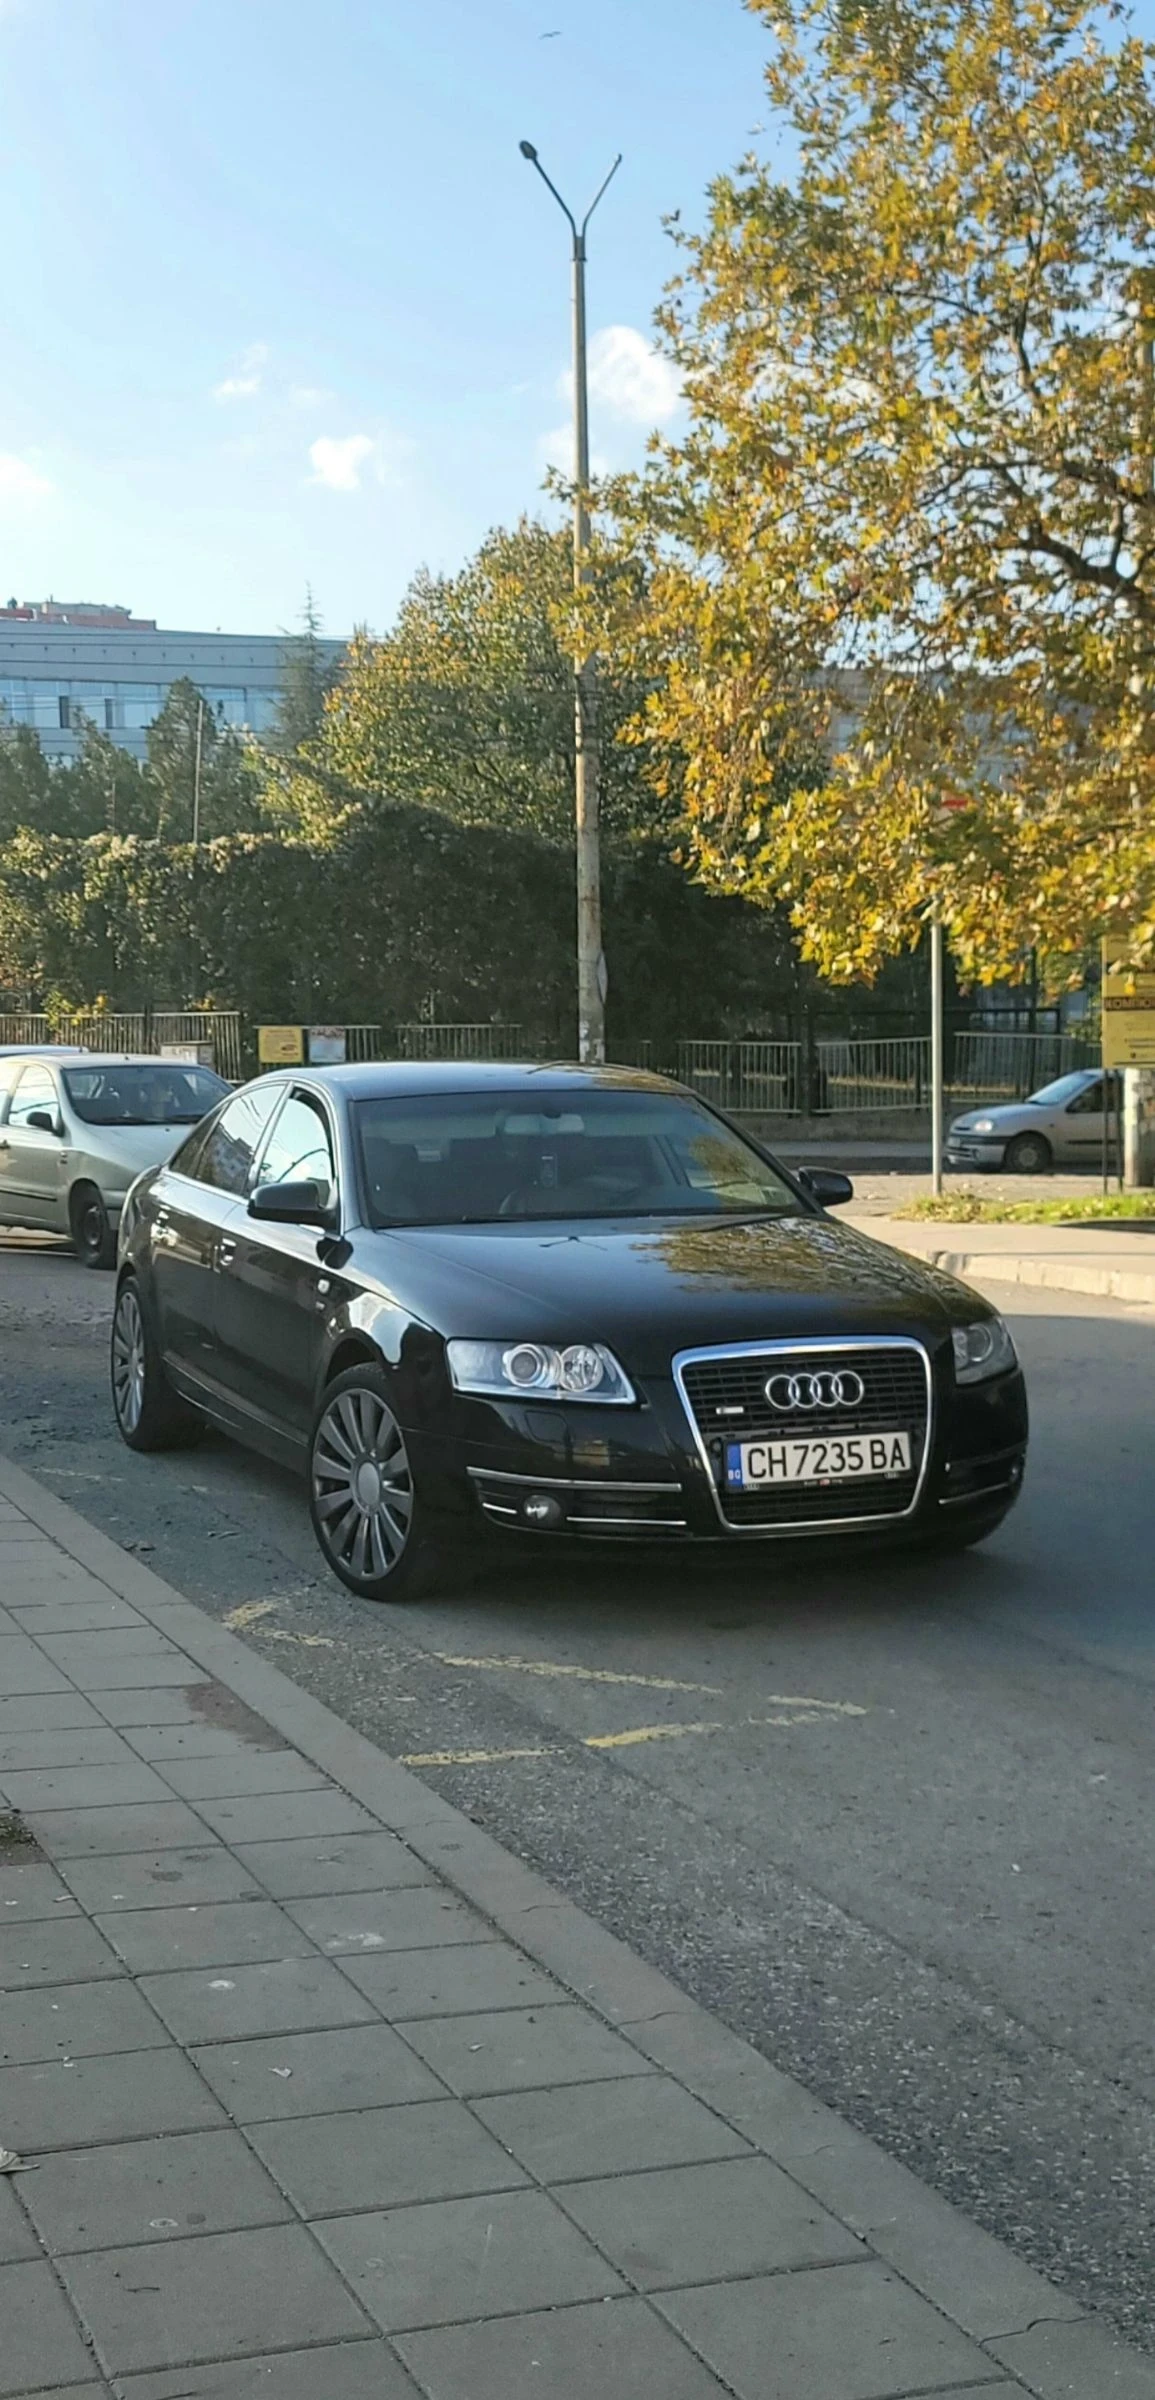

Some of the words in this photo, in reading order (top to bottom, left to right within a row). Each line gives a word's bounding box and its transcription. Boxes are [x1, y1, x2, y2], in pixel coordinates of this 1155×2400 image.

[748, 1446, 787, 1479] CH
[793, 1441, 864, 1476] 7235
[870, 1438, 906, 1470] BA
[727, 1469, 741, 1480] BG
